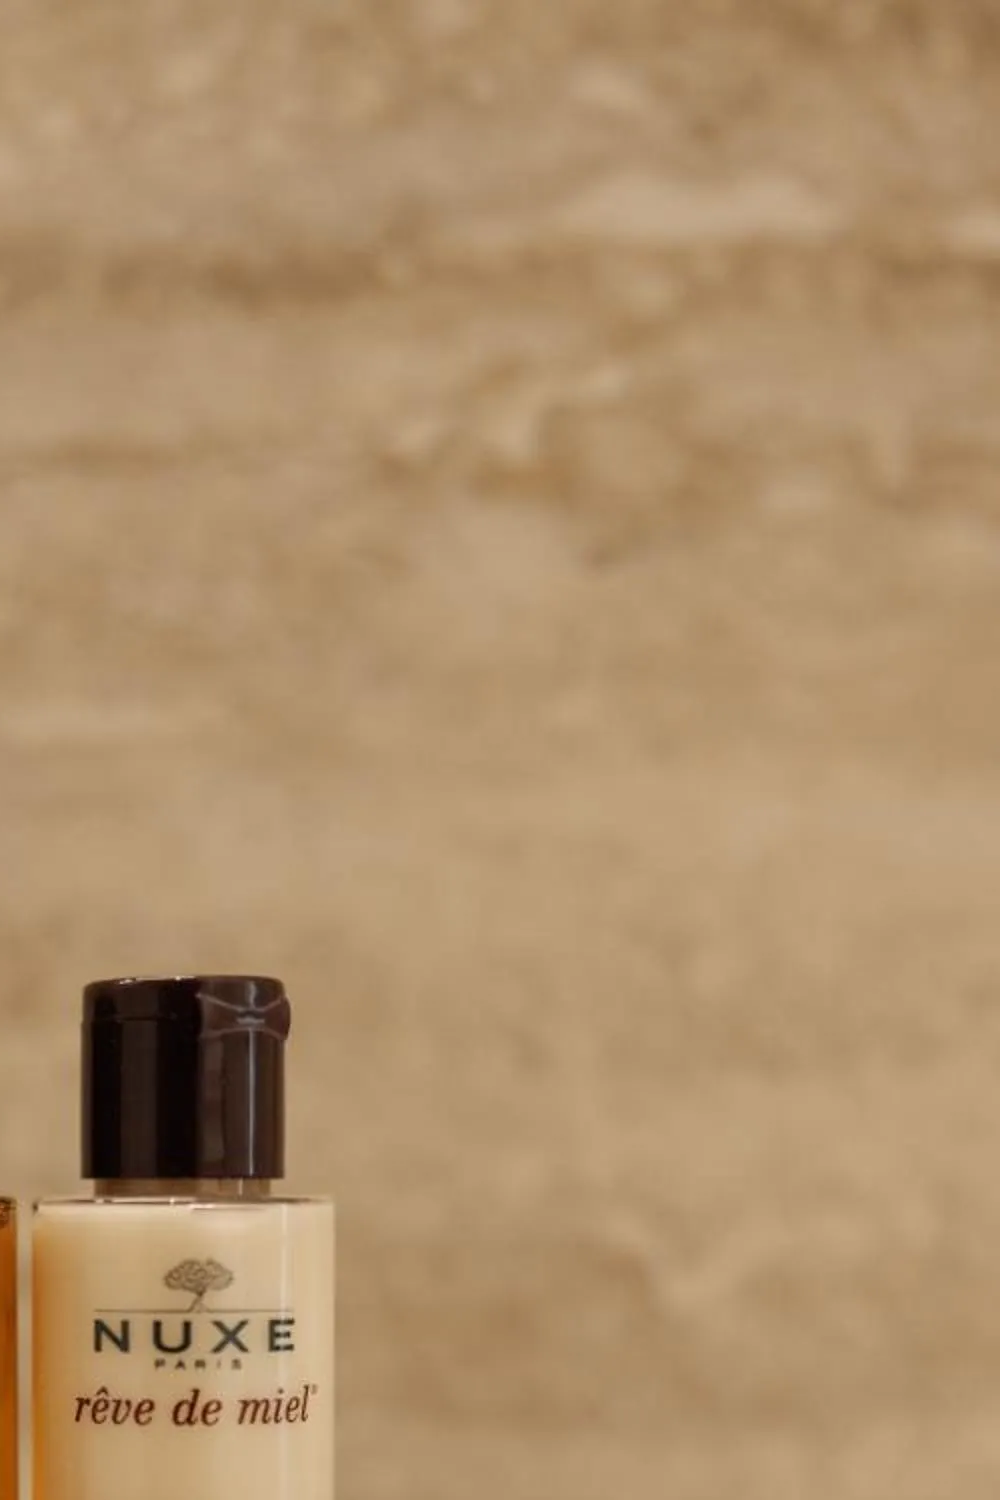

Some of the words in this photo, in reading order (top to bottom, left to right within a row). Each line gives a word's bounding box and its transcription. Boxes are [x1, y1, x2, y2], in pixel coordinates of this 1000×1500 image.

[93, 1318, 296, 1354] NUXE
[154, 1359, 242, 1370] PARIS
[74, 1386, 155, 1426] rêve
[171, 1387, 223, 1427] de
